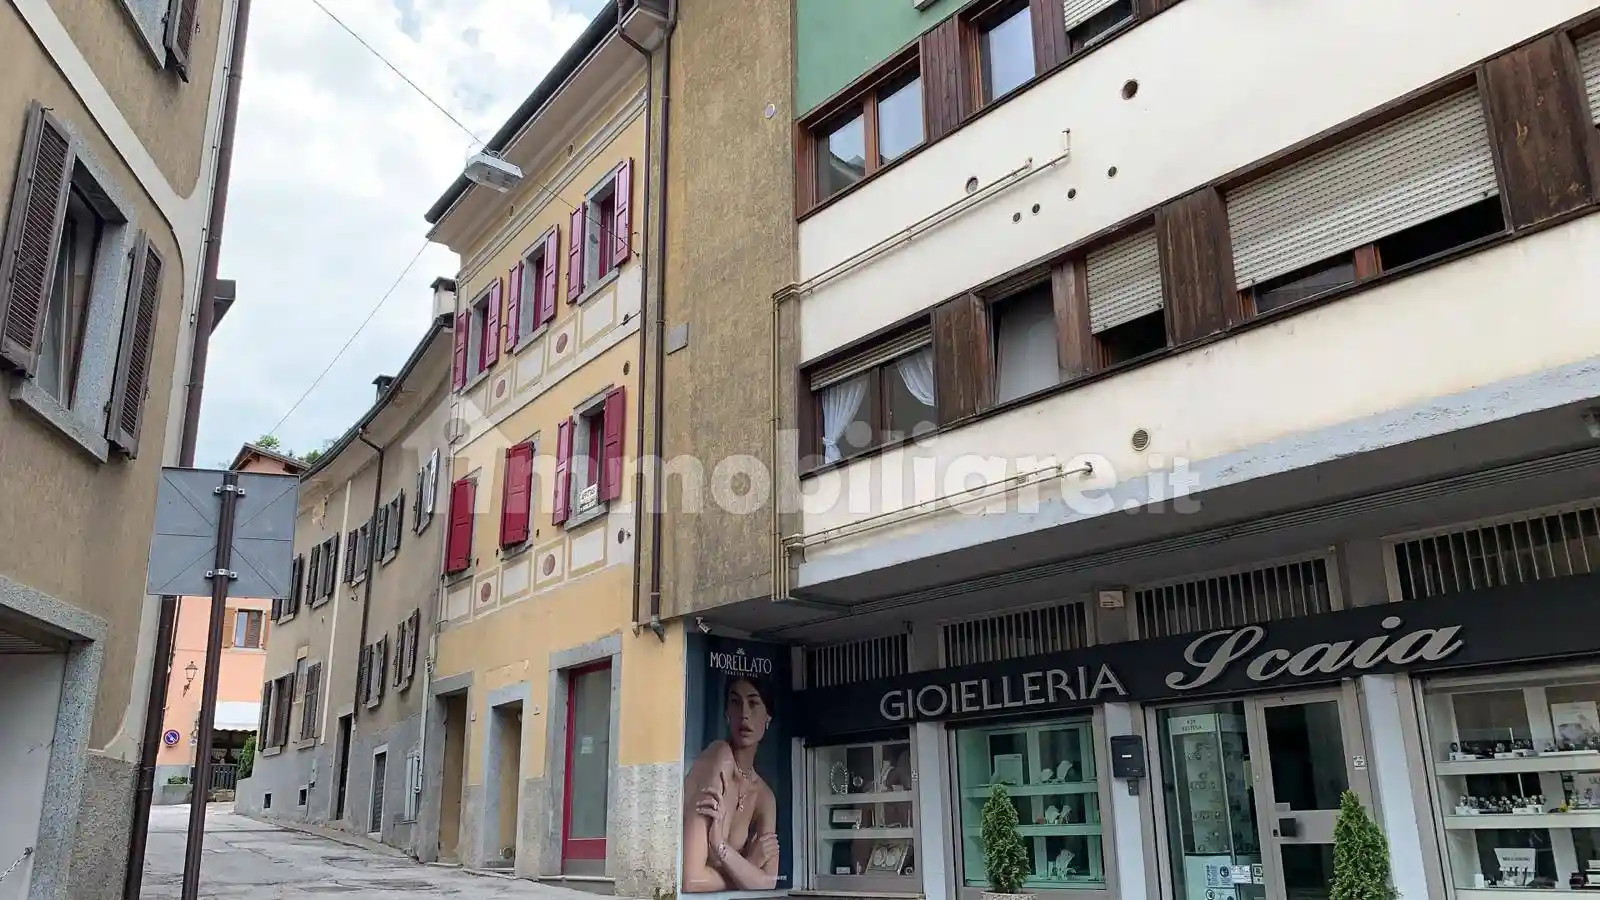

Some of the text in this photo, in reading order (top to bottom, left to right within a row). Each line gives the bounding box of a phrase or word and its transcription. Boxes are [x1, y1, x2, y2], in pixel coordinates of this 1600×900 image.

[710, 651, 772, 674] MORELLATO
[879, 616, 1463, 721] GIOIELLERIA Scaia
